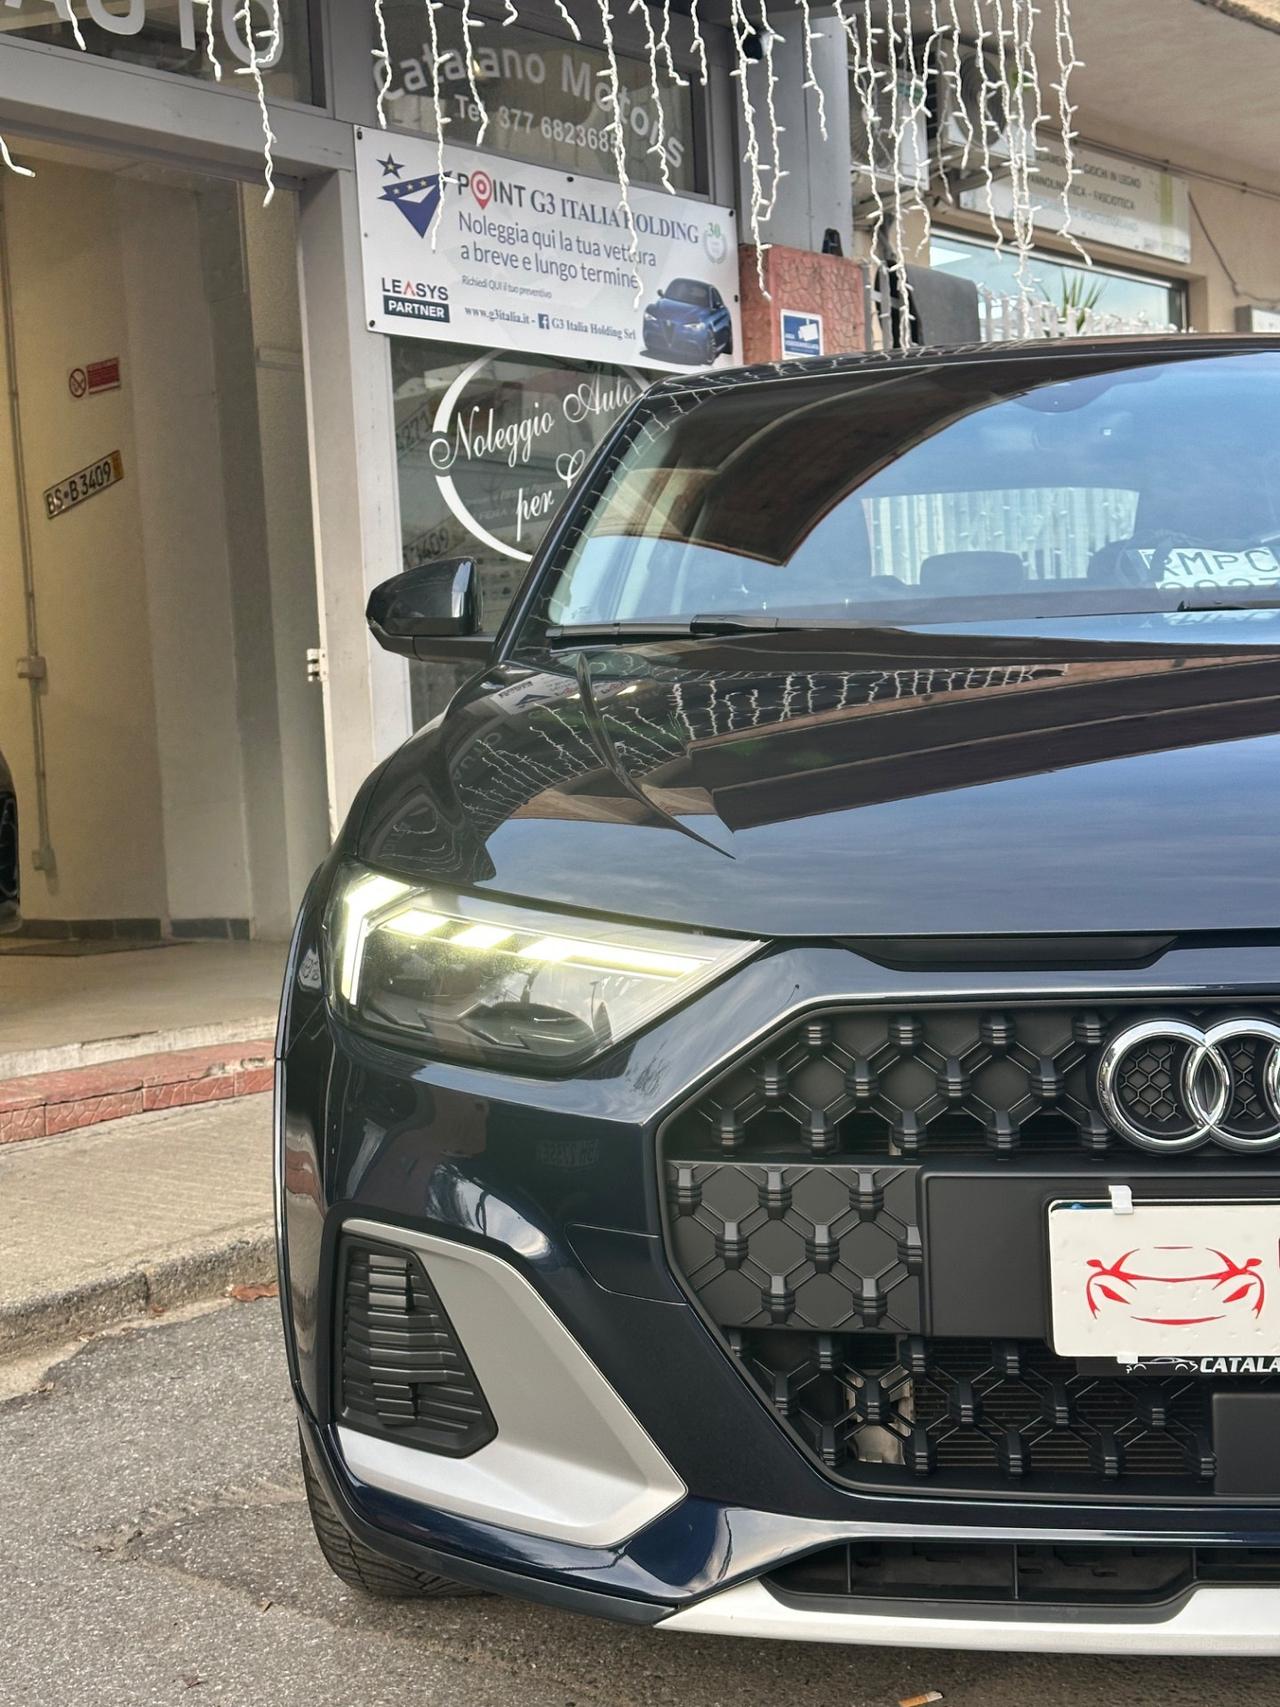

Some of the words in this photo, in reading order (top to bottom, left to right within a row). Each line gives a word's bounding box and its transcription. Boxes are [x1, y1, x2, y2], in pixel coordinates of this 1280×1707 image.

[372, 43, 546, 100] Cataano
[499, 105, 535, 134] 377
[458, 170, 526, 209] POINT
[530, 189, 556, 215] G3
[561, 198, 620, 229] ITALIA
[623, 209, 700, 244] HOLDING
[458, 211, 529, 246] Noleggia
[532, 228, 556, 251] qui
[559, 230, 573, 252] la
[575, 237, 601, 257] tua
[603, 242, 657, 267] vettura
[381, 277, 449, 301] LEASYS
[460, 243, 470, 260] a
[473, 241, 519, 269] breve
[522, 256, 532, 271] e
[535, 252, 578, 282] lungo
[581, 262, 639, 290] termine
[388, 301, 446, 319] PARTNER
[464, 305, 530, 325] www.g3italia.it
[552, 317, 564, 330] G3
[566, 319, 589, 333] Italia
[590, 322, 623, 340] Holding
[624, 328, 637, 341] Srl
[429, 402, 555, 470] Noleggio
[563, 373, 636, 422] Auto
[516, 487, 555, 542] per
[1201, 1357, 1280, 1374] CATALA
